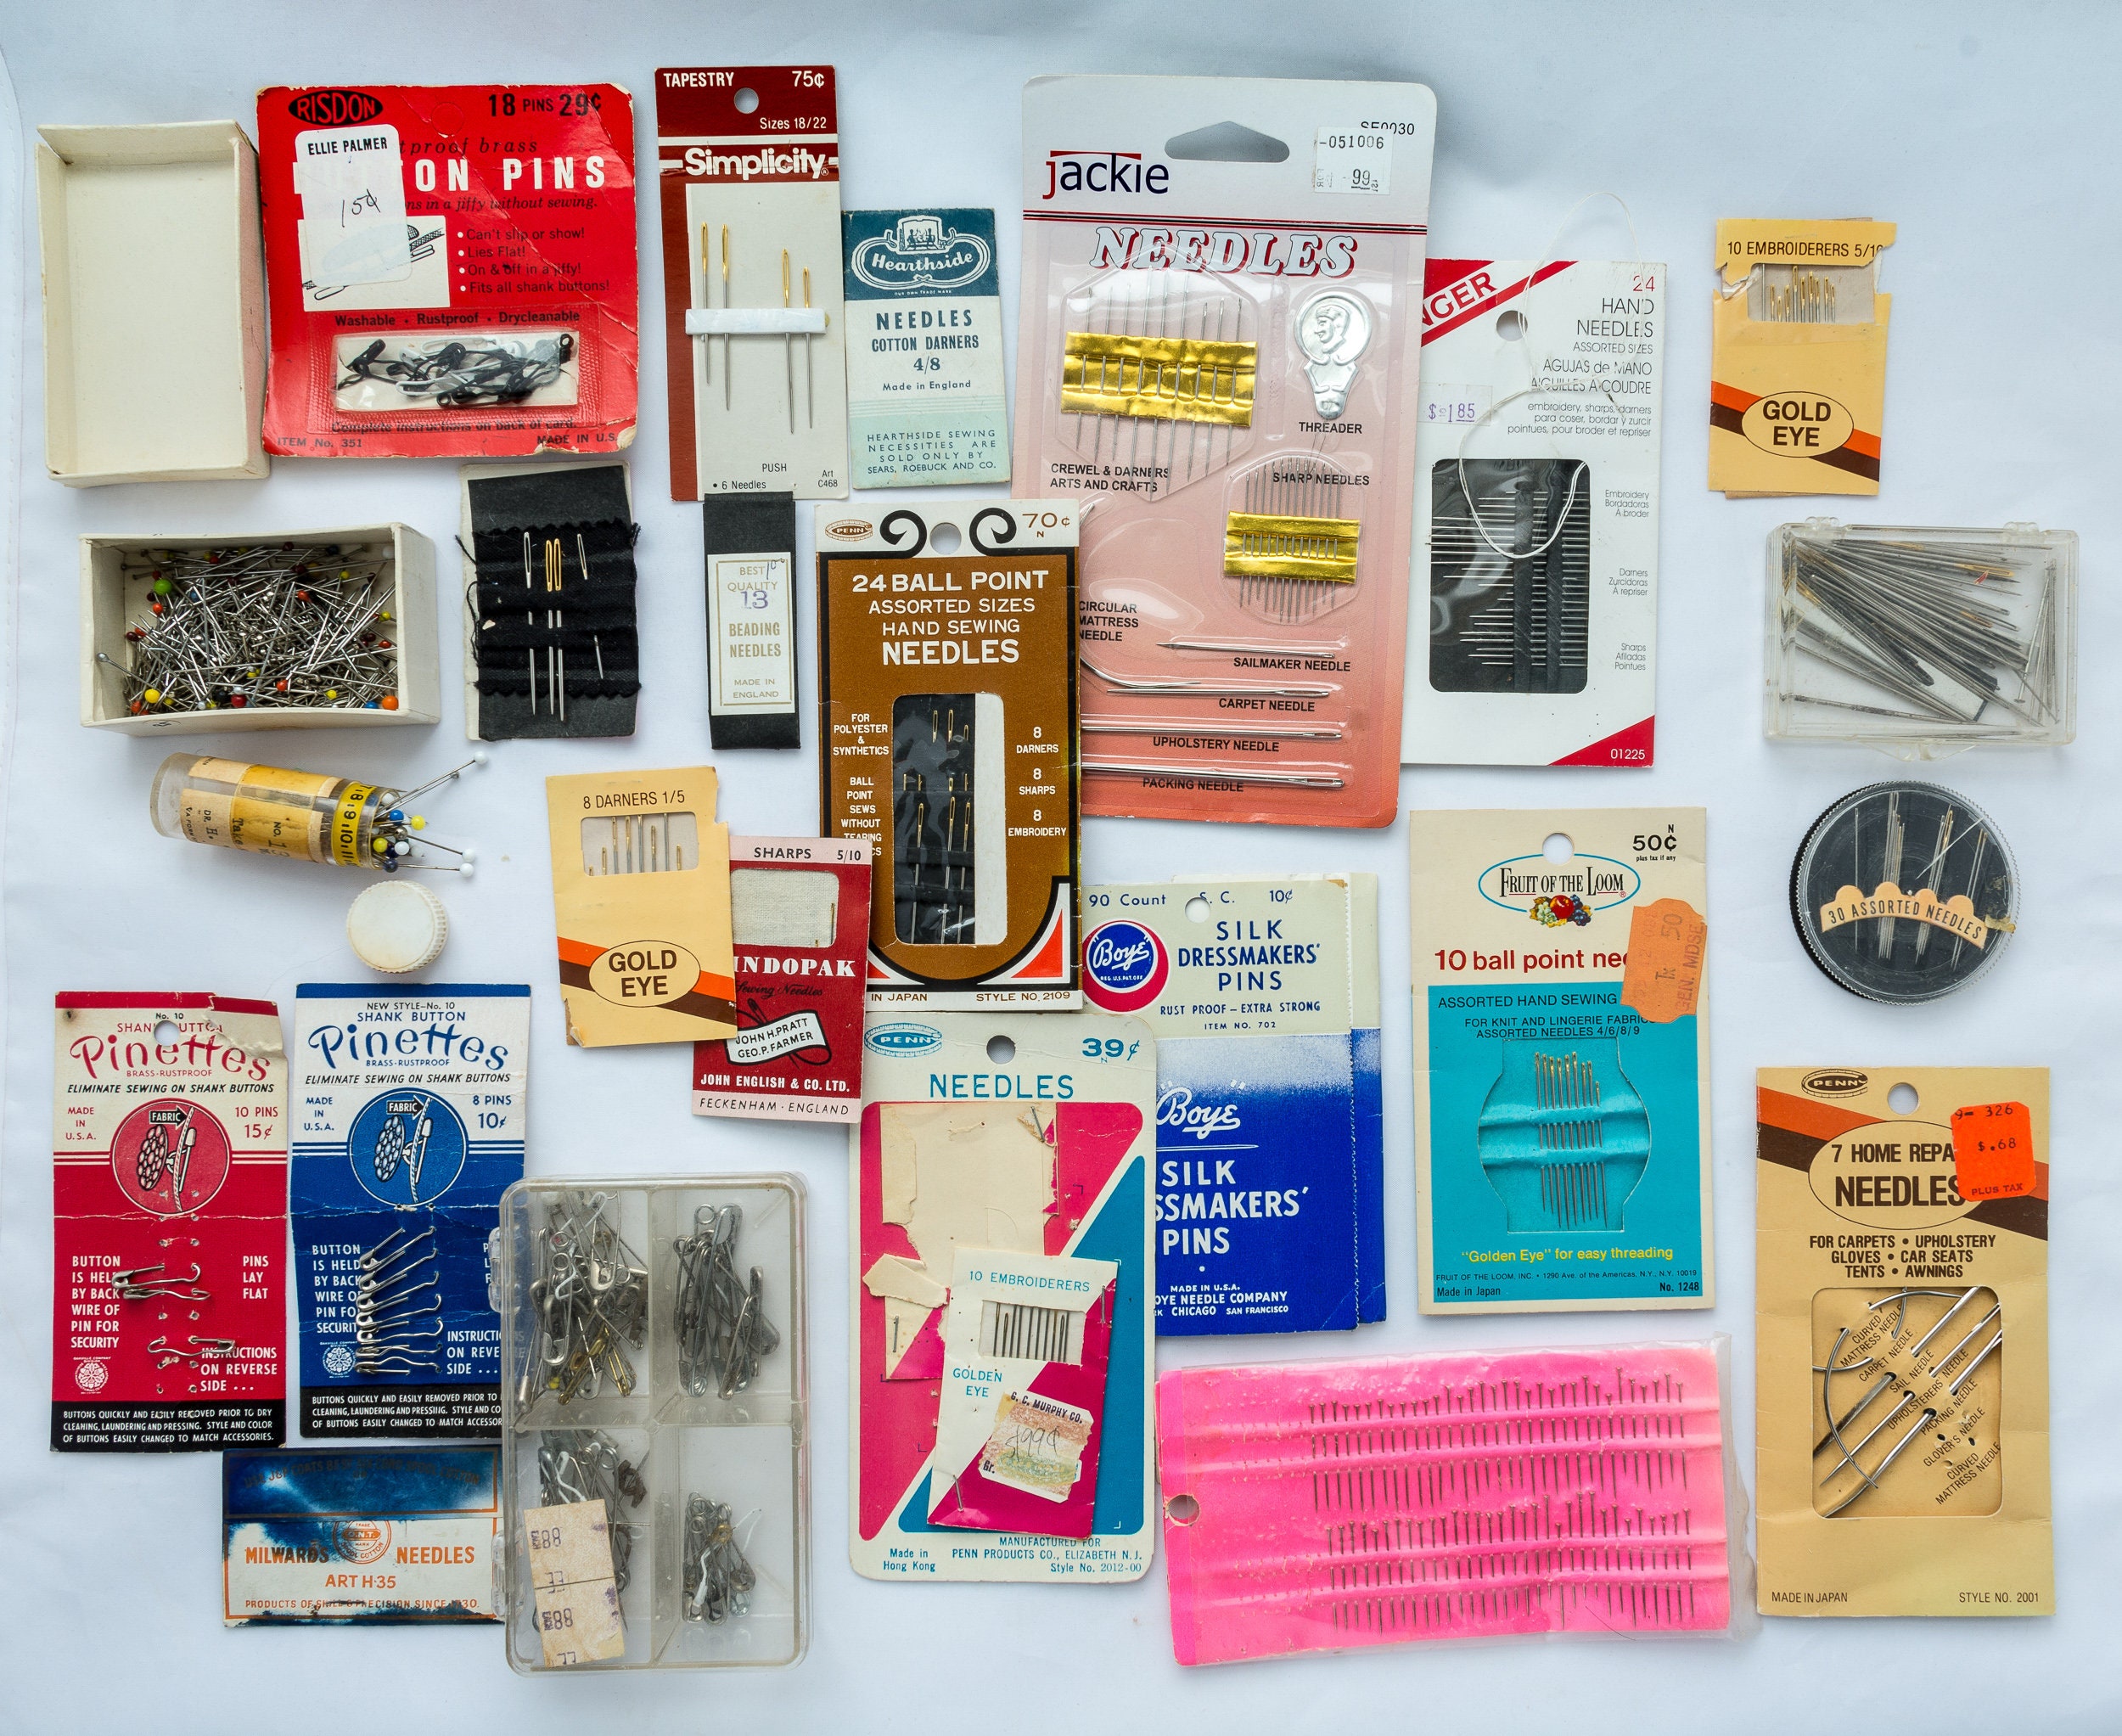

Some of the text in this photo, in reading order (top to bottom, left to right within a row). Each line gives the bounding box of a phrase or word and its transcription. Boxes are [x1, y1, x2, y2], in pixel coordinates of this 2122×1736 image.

[663, 70, 824, 88] TAPESTRY 75¢
[297, 93, 376, 122] RISDON
[489, 93, 601, 116] 18 PINS 29¢
[760, 117, 827, 129] Sizes 18/22
[307, 137, 387, 154] ELLIE PALMER
[480, 139, 537, 153] brass
[503, 156, 605, 191] PINS
[1042, 151, 1169, 199] jackie
[1090, 227, 1357, 278] NEEDLES
[1727, 242, 1849, 256] 10 EMBROIDERERS
[872, 251, 973, 272] Hearthside
[1633, 275, 1655, 292] 24
[335, 311, 580, 326] Washable Rustproof Drycleanable
[876, 310, 973, 330] NEEDLES
[872, 336, 979, 351] COTTON DARNERS
[1573, 342, 1625, 353] ASSORTED
[913, 357, 940, 373] 4/8
[1543, 359, 1610, 374] AGUJAS de
[883, 379, 971, 390] Made in England
[1763, 400, 1831, 422] GOLD
[1299, 421, 1362, 434] THREADER
[1552, 425, 1572, 435] pour
[1575, 425, 1605, 435] broder
[1608, 426, 1617, 435] et
[1620, 427, 1651, 436] repriser
[867, 430, 996, 442] HEARTHSIDE SEWING
[1773, 426, 1820, 447] EYE
[762, 463, 788, 473] PUSH
[1620, 568, 1648, 576] Darners
[852, 570, 1048, 592] 24 BALL POINT
[868, 598, 1035, 614] ASSORTED SIZES
[729, 622, 780, 637] BEADING
[730, 643, 781, 657] NEEDLES
[883, 639, 1019, 665] NEEDLES
[1233, 657, 1350, 671] SAILMAKER NEEDLE
[1219, 698, 1315, 712] CARPET NEEDLE
[834, 725, 888, 733] POLYESTER
[1610, 749, 1645, 760] 01225
[583, 790, 685, 809] 8 DARNERS 1/5
[1008, 828, 1066, 837] EMBROIDERY
[1632, 834, 1677, 851] 50¢
[754, 847, 861, 863] SHARPS 5/10
[1541, 875, 1557, 892] OF
[1559, 875, 1583, 892] THE
[1089, 890, 1293, 907] 90 Count 10¢
[1828, 900, 1982, 940] 30 ASSORTED NEEDLES
[1216, 920, 1283, 941] SILK
[609, 950, 676, 972] GOLD
[1434, 949, 1584, 973] 10 ball point
[621, 975, 668, 997] EYE
[976, 992, 1016, 1002] STYLE
[1043, 992, 1070, 1001] 2109
[1160, 1001, 1321, 1015] RUST PROOF EXTRA STRONG
[357, 1012, 465, 1021] SHANK BUTTON
[308, 1024, 508, 1070] Pinettes
[70, 1034, 271, 1081] Pinettes
[306, 1073, 510, 1085] ELIMINATE SEWING ON SHANK BUTTONS
[700, 1074, 785, 1088] JOHN ENGLISH
[929, 1074, 1074, 1099] NEEDLES
[699, 1098, 849, 1115] FECKENHAM ENGLAND
[478, 1113, 507, 1129] 10¢
[244, 1124, 273, 1140] 15¢
[1832, 1144, 1901, 1162] 7 HOME
[1835, 1175, 1966, 1206] NEEDLES
[1810, 1235, 1996, 1248] FOR CARPETS UPHOLSTERY
[1555, 1249, 1575, 1260] for
[1577, 1250, 1607, 1261] easy
[1611, 1247, 1673, 1260] threading
[1845, 1266, 1962, 1278] TENTS AWNINGS
[969, 1271, 1090, 1292] 10 EMBROIDERERS
[1230, 1292, 1287, 1303] COMPANY
[1436, 1285, 1501, 1298] Made in Japan
[1172, 1306, 1288, 1316] CHICAGO SAN FRANCISCO
[71, 1336, 119, 1348] SECURITY
[226, 1363, 278, 1374] REVERSE
[953, 1368, 1002, 1382] GOLDEN
[1889, 1350, 1934, 1394] SAIL NEEDLE
[966, 1386, 989, 1397] EYE
[347, 1396, 378, 1404] QUICKLY
[1032, 1398, 1068, 1418] MURPHY
[396, 1546, 475, 1565] NEEDLES
[952, 1549, 1059, 1560] PENN PRODUCTS CO.,
[884, 1560, 935, 1571] Hong Kong
[325, 1575, 357, 1588] ART
[1772, 1592, 1847, 1603] MADE IN JAPAN
